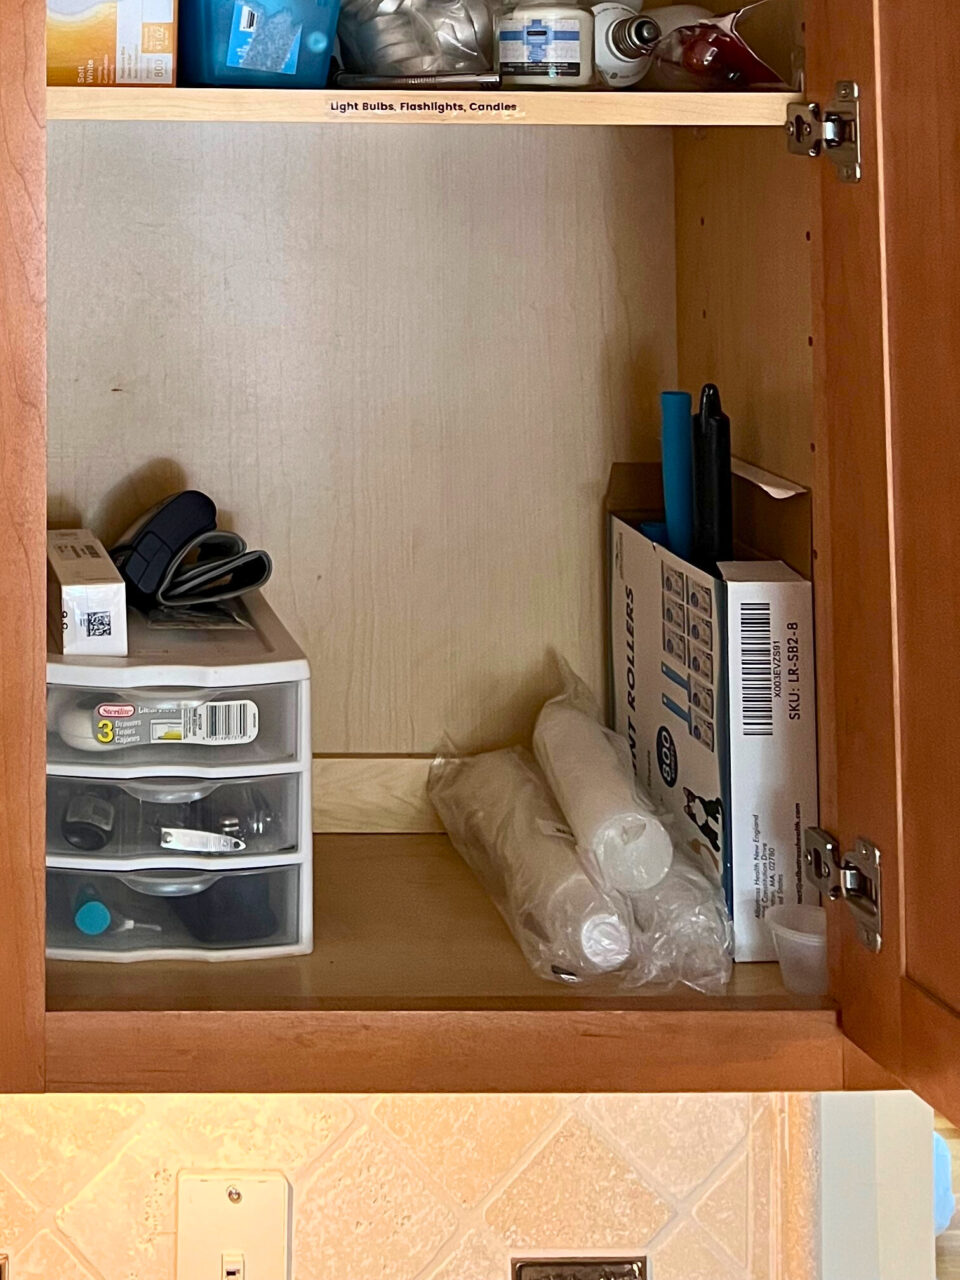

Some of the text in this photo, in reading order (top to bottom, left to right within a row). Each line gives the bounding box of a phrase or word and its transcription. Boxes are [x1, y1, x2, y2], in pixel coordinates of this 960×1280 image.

[86, 59, 94, 84] White
[154, 59, 164, 78] 800
[331, 102, 517, 113] Light Bulbs, Flashlights, Candles
[624, 584, 636, 713] ROLLERS
[786, 621, 801, 721] SKU: LR-SB2-8
[101, 705, 133, 716] Sterilite
[97, 719, 114, 743] 3
[115, 719, 142, 729] Drawers
[659, 731, 672, 783] 800
[752, 814, 761, 843] England
[760, 842, 769, 904] Constitution Drive
